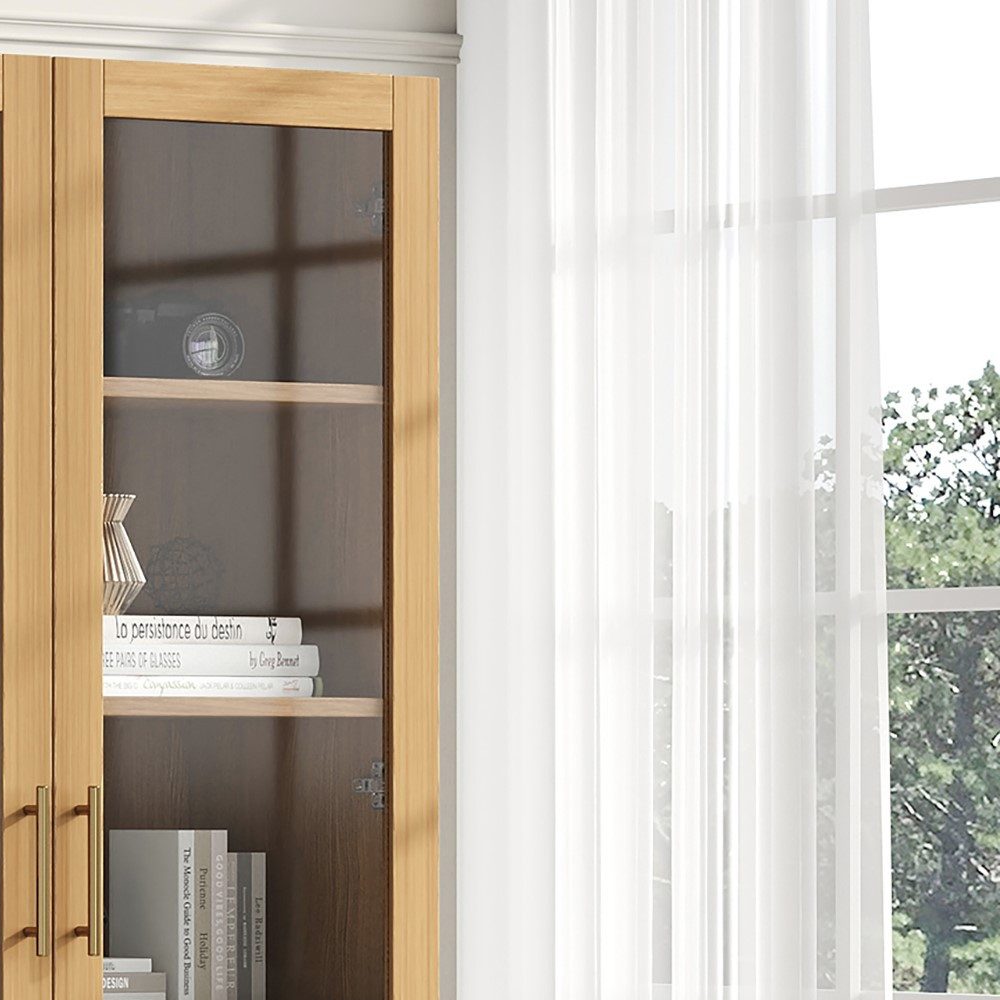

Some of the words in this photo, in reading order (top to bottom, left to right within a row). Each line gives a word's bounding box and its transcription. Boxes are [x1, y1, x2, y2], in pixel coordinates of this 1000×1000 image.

[129, 617, 191, 645] persistance
[194, 615, 207, 640] du
[211, 616, 243, 640] destin
[102, 651, 114, 668] EE
[115, 651, 136, 668] PAIRS
[138, 651, 148, 668] OF
[150, 652, 182, 669] GLASSES
[249, 651, 258, 670] by
[259, 651, 276, 670] Greg
[216, 854, 224, 888] GOOD
[183, 901, 192, 926] Guide
[183, 928, 191, 936] to
[255, 917, 264, 963] Radziwill
[183, 937, 192, 960] Good
[197, 932, 209, 970] Holiday
[183, 962, 192, 996] Business
